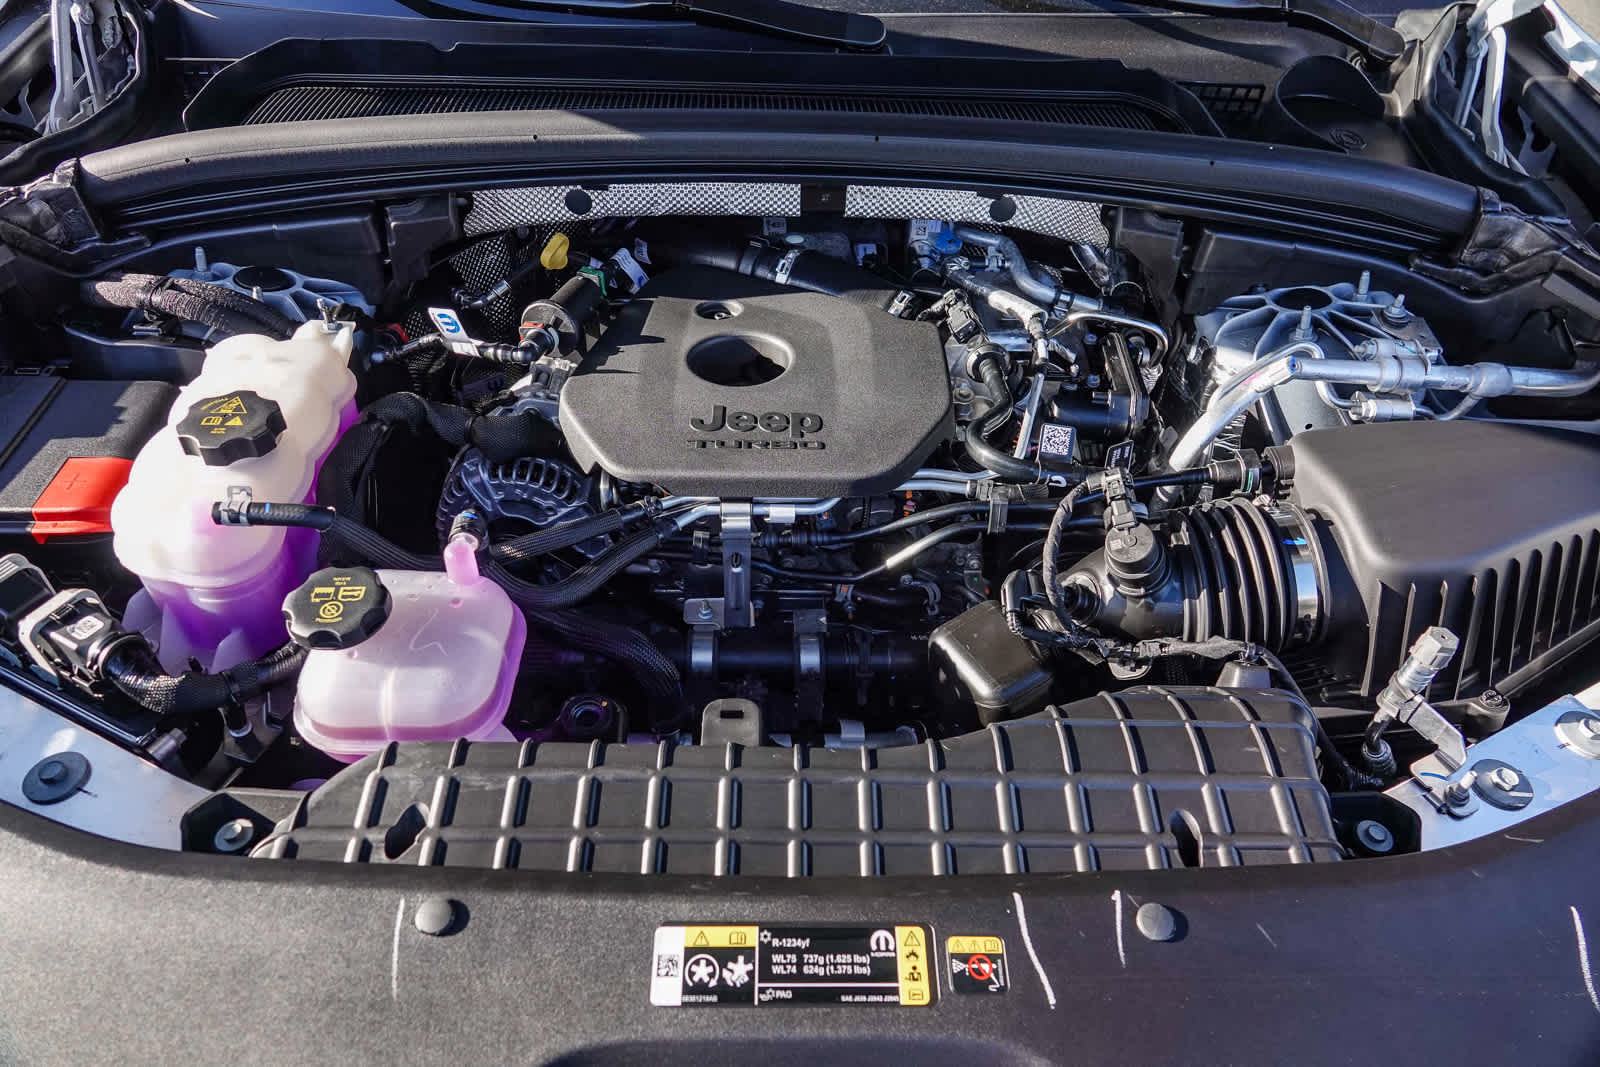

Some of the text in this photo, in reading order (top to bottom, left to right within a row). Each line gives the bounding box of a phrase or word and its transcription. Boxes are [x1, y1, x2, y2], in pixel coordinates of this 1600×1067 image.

[689, 405, 824, 439] Jeep
[687, 439, 826, 450] TURBO
[772, 938, 810, 949] R-1234yf
[772, 954, 797, 964] WL75
[803, 954, 825, 965] 737g
[826, 954, 852, 965] (1.625
[854, 954, 871, 965] lbs)
[772, 965, 871, 976] WL74 624g (1.375 lbs)
